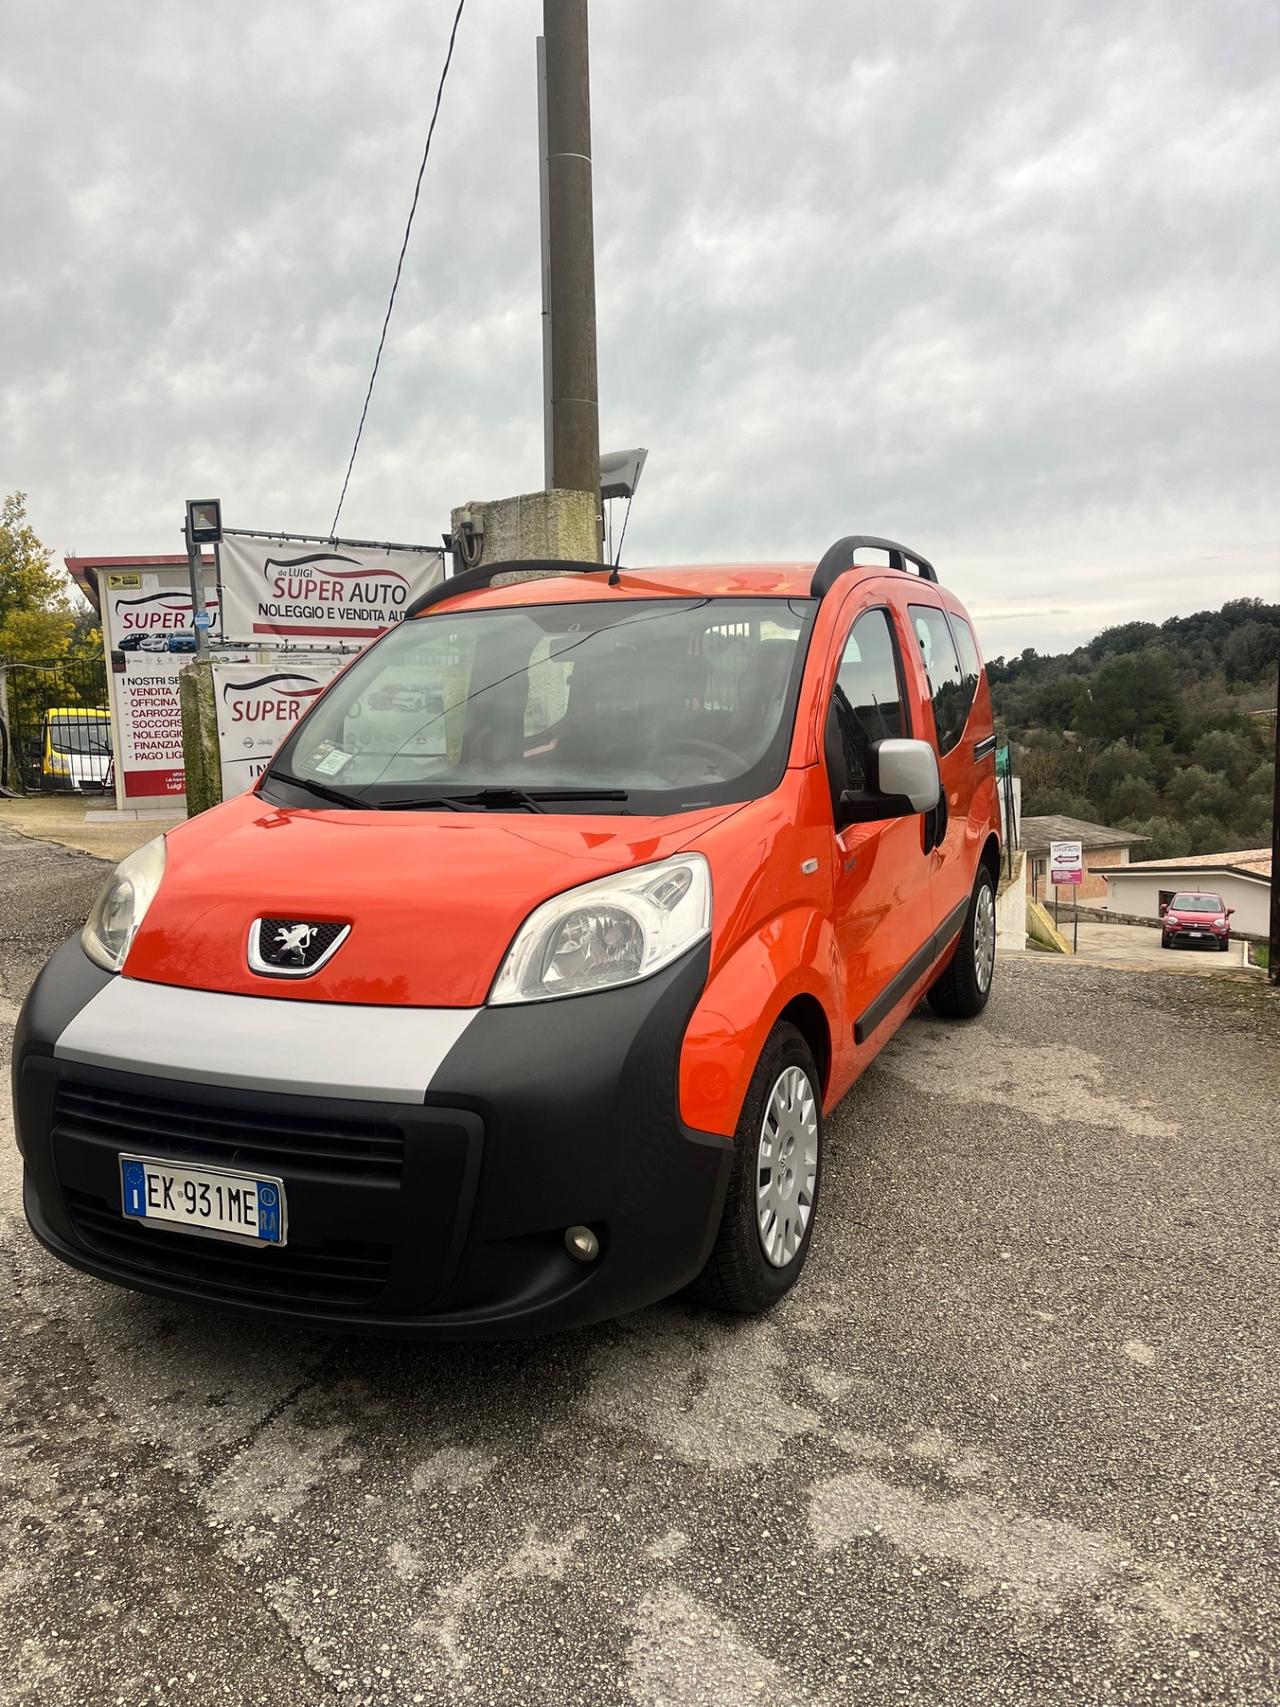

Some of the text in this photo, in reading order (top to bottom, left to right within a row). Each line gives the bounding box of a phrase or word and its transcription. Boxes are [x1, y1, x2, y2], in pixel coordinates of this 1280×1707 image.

[288, 569, 313, 578] LUIGI
[273, 577, 407, 605] SUPER AUTO
[258, 603, 324, 619] NOLEGGIO
[327, 607, 335, 620] E
[338, 608, 385, 622] VENDITA
[123, 612, 185, 629] SUPER
[122, 678, 125, 686] I
[127, 676, 166, 686] NOSTRI
[130, 687, 173, 696] VENDITA
[130, 698, 178, 707] OFFICINA
[131, 708, 182, 718] CARROZZ
[232, 700, 301, 722] SUPER
[135, 752, 163, 761] PAGO
[147, 1173, 257, 1227] EK 931ME
[259, 1210, 277, 1232] RA
